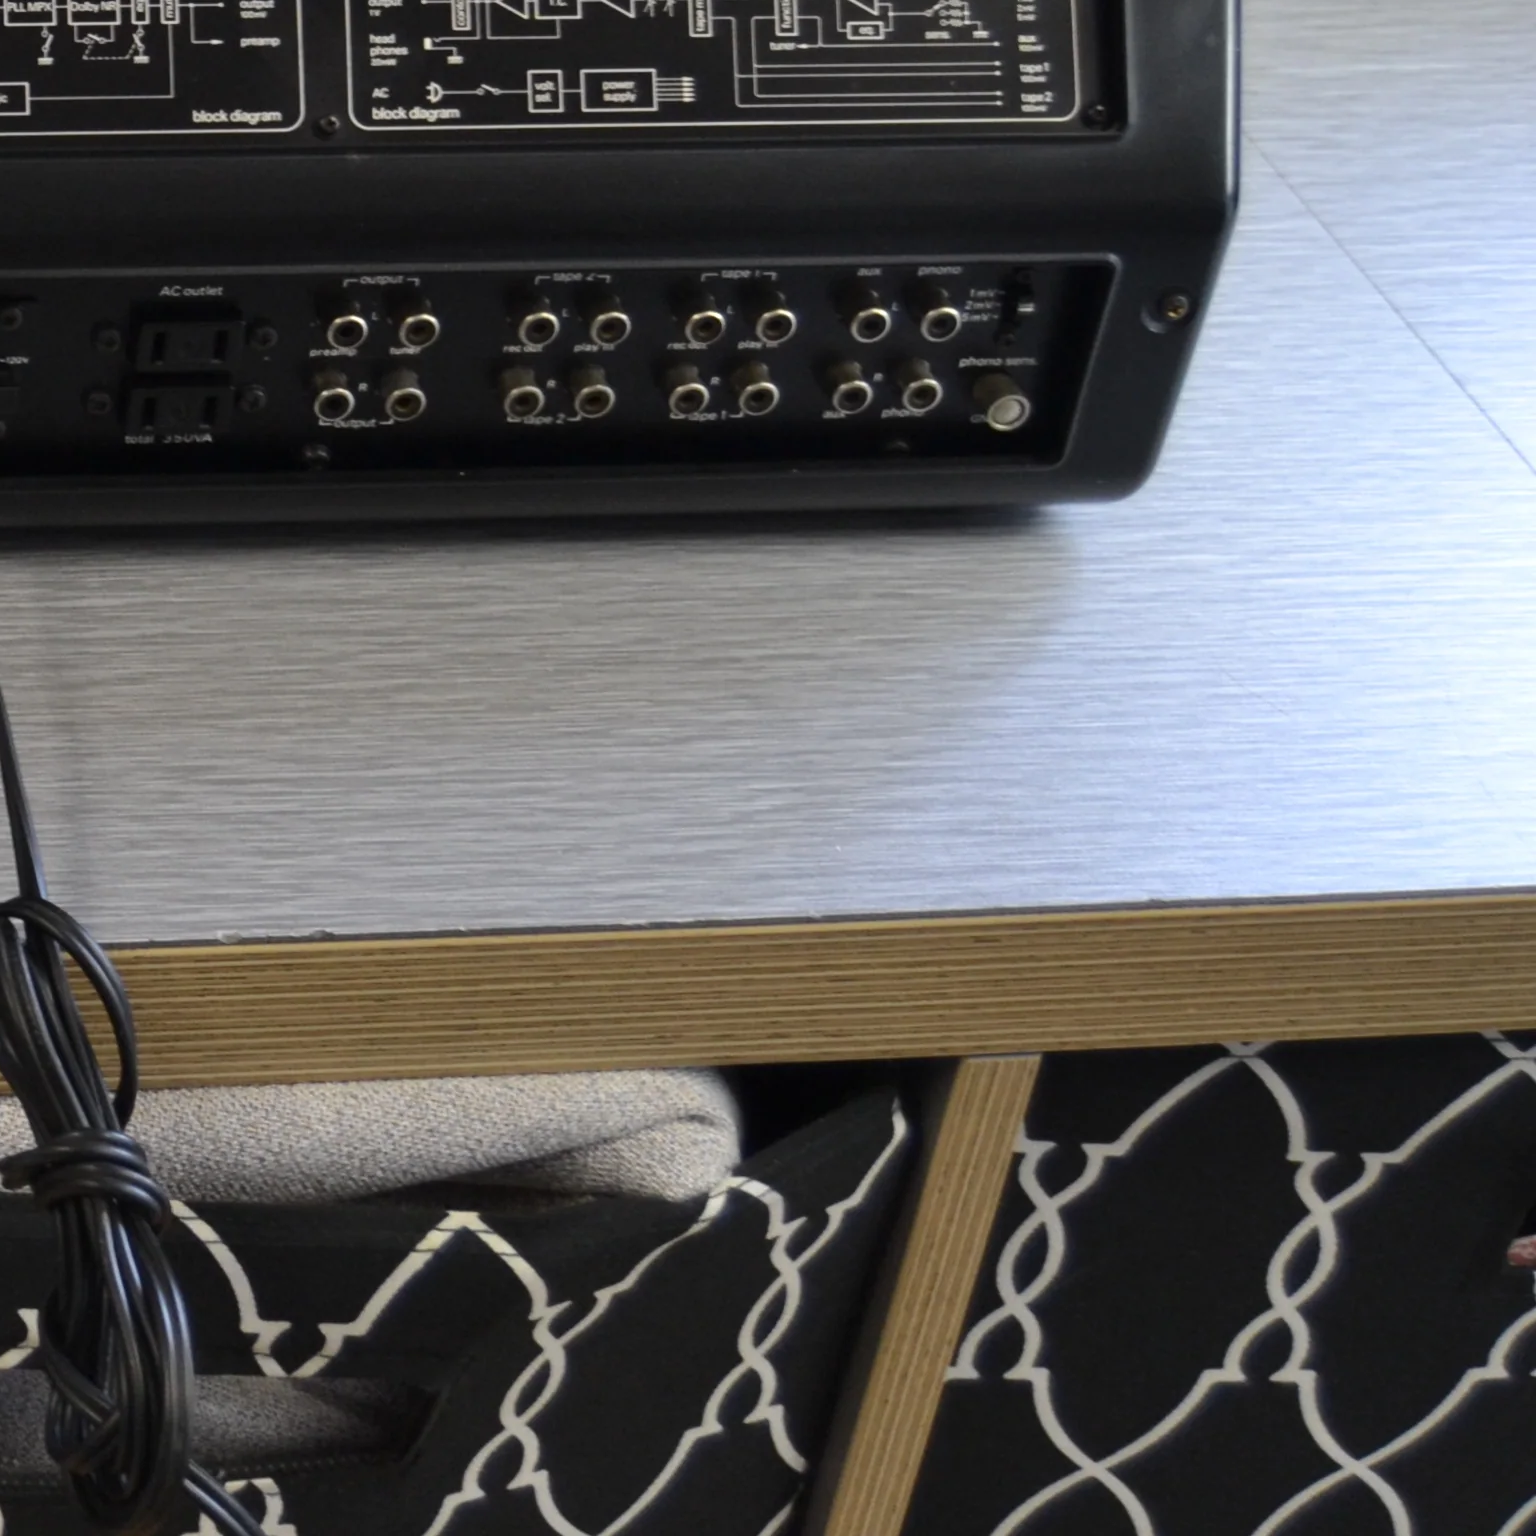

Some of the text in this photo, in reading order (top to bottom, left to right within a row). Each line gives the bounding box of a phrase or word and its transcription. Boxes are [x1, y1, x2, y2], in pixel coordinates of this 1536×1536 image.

[70, 0, 99, 12] Dolby
[369, 33, 396, 45] head
[372, 88, 390, 99] AC
[192, 109, 282, 125] block diagram
[372, 105, 461, 123] block diagram
[857, 267, 883, 276] aux
[917, 265, 964, 277] phono
[360, 275, 404, 286] output
[158, 285, 224, 297] AC outlet
[958, 356, 1003, 368] phono
[358, 382, 368, 392] R
[333, 417, 377, 429] output
